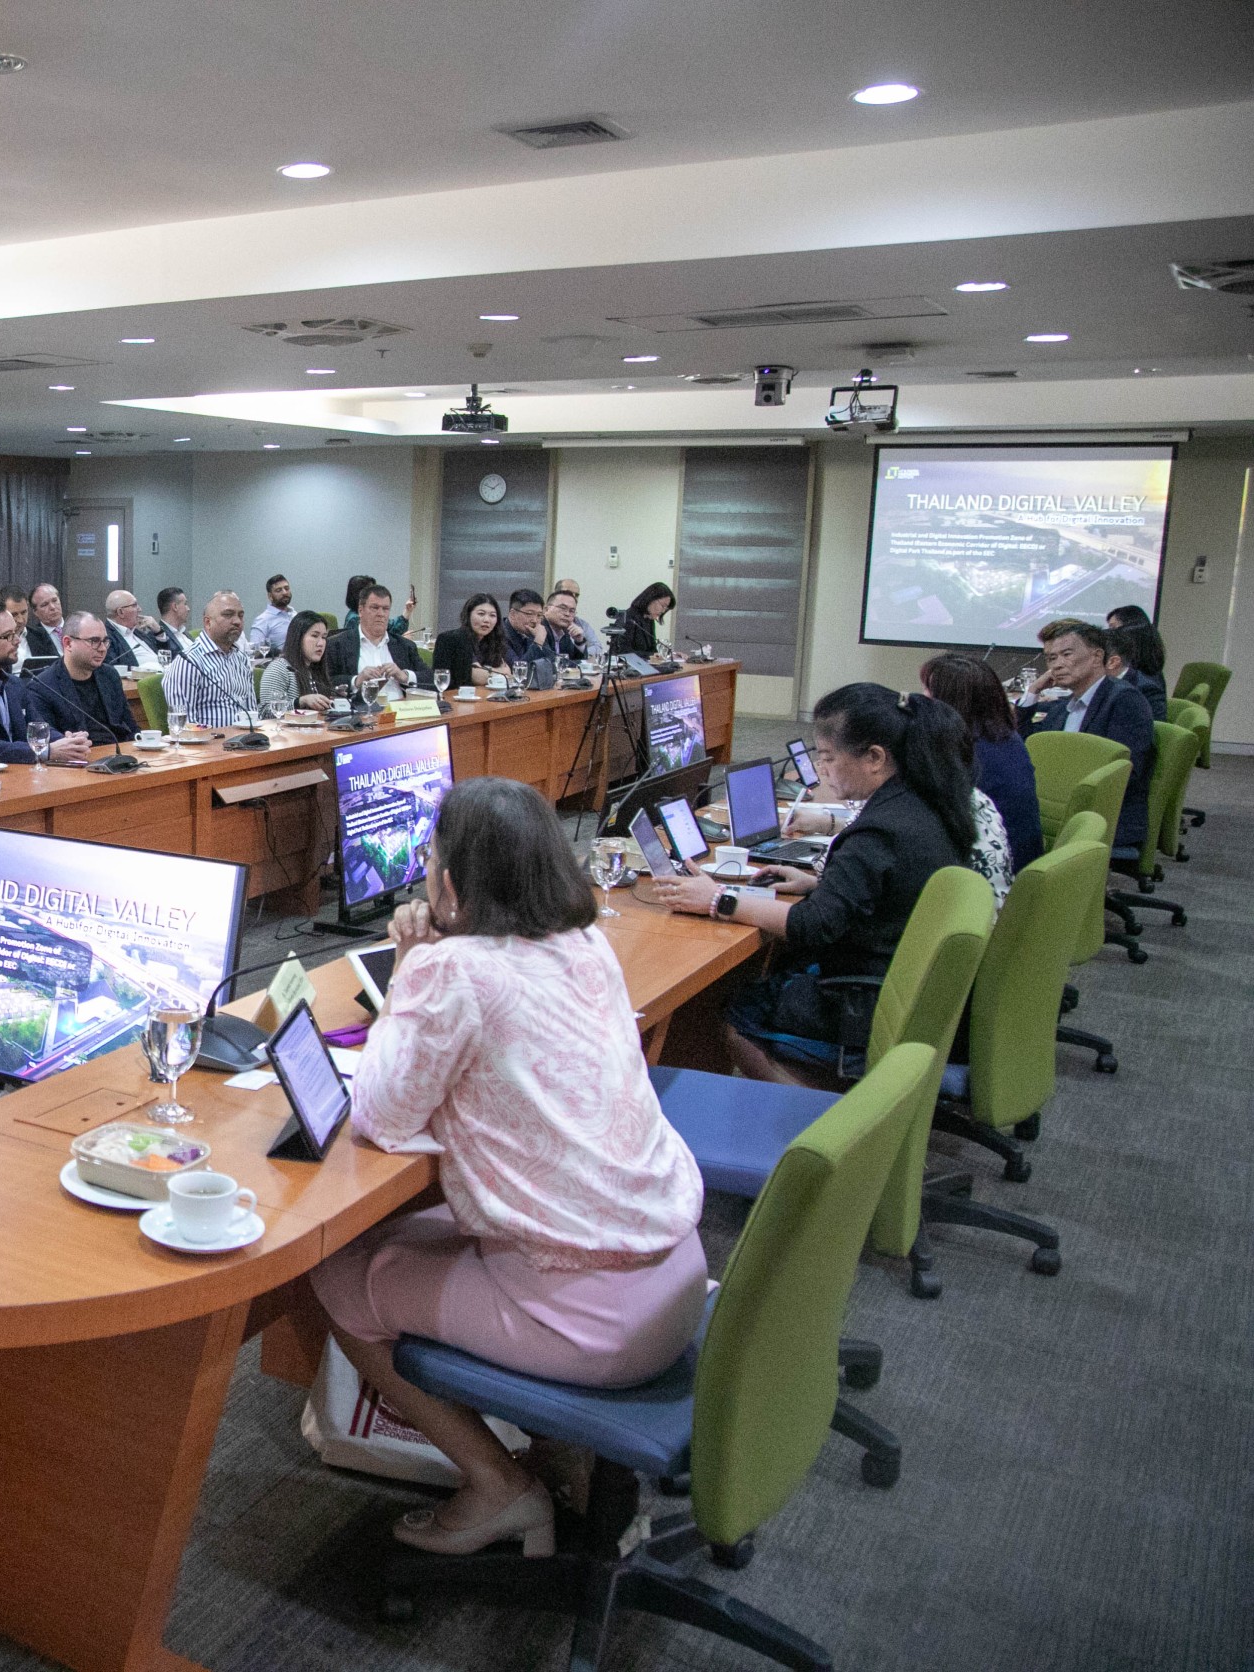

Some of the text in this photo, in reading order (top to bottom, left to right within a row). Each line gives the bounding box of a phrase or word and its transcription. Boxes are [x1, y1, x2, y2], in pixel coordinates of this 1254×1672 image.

[907, 494, 1147, 512] THAILAND DIGITAL VALLEY
[1062, 515, 1091, 524] Digital
[1094, 516, 1145, 525] Innovation
[348, 769, 387, 792] THAILAND
[387, 762, 415, 782] DIGITAL
[24, 883, 105, 918] DIGITAL
[113, 897, 196, 932] VALLEY
[46, 916, 191, 951] A Hub for Digital Innovation
[0, 935, 35, 950] Promotion
[35, 943, 52, 954] Zone
[52, 947, 62, 955] of
[12, 951, 21, 959] of
[3, 960, 18, 970] EEC
[383, 1428, 432, 1446] CONSENSU
[386, 1425, 426, 1440] SUSTAINAB
